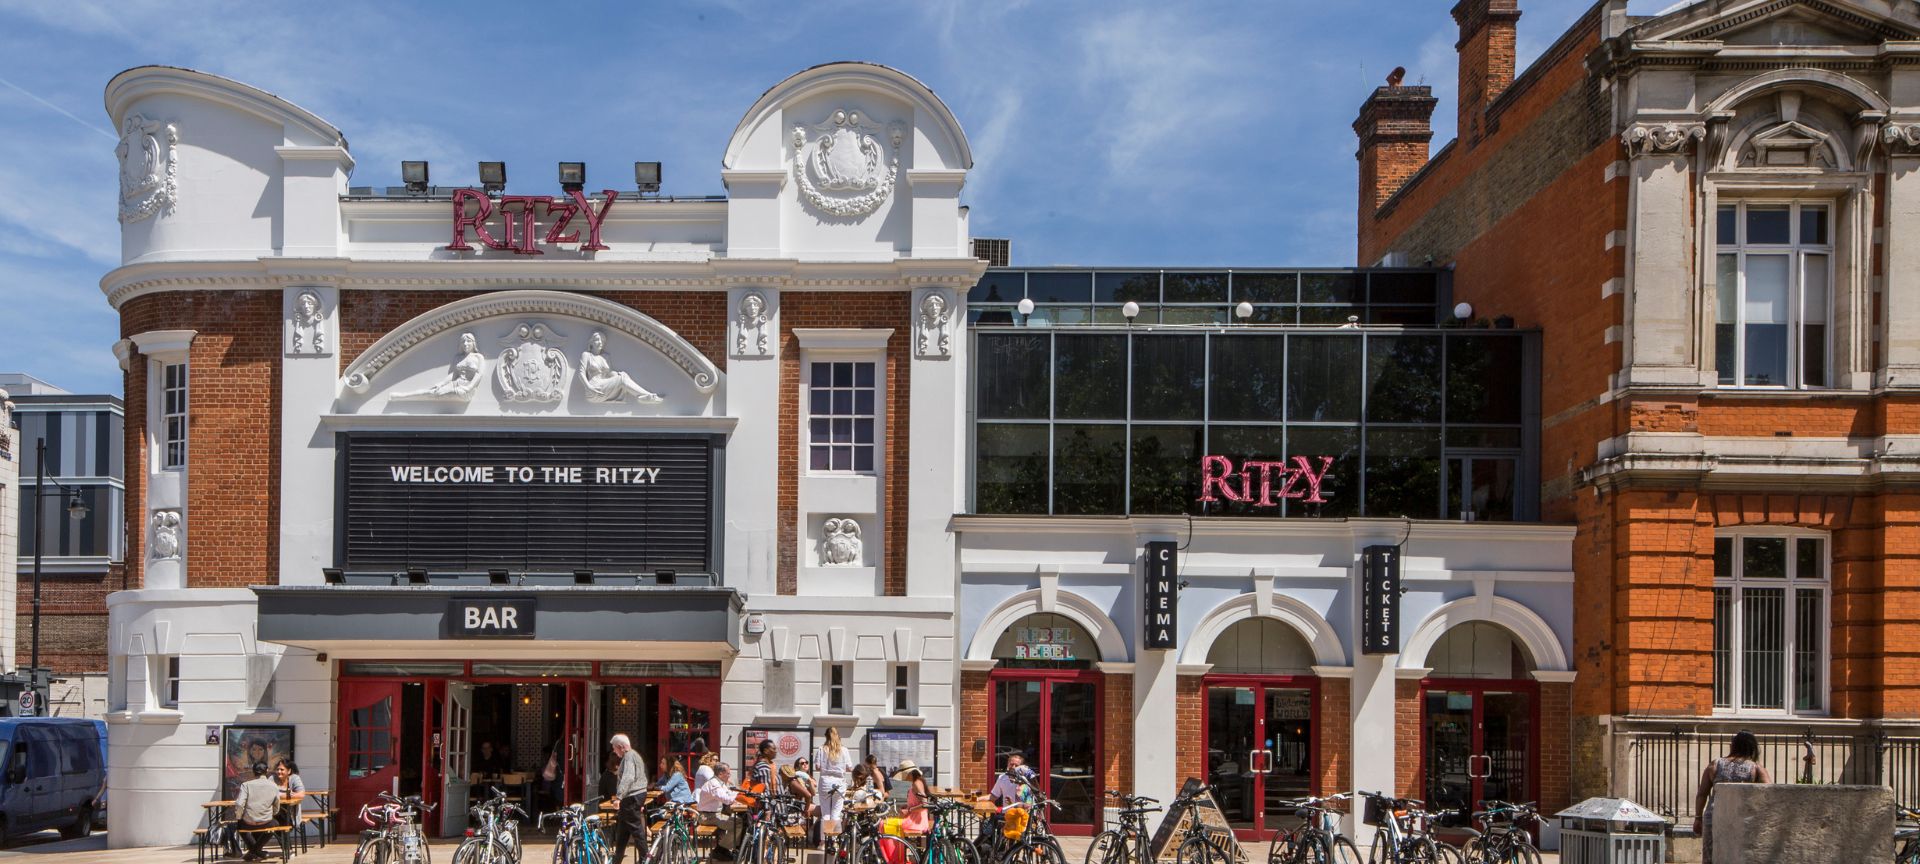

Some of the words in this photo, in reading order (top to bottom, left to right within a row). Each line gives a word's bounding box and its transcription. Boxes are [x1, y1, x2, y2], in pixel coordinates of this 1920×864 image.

[391, 466, 494, 483] WELCOME
[505, 467, 534, 483] TO
[541, 467, 582, 483] THE
[596, 467, 660, 484] RITZY
[1157, 549, 1170, 641] CINEMA
[1382, 552, 1390, 646] TICKETS
[464, 606, 519, 629] BAR
[1016, 644, 1075, 660] REBEL
[784, 741, 795, 749] UP
